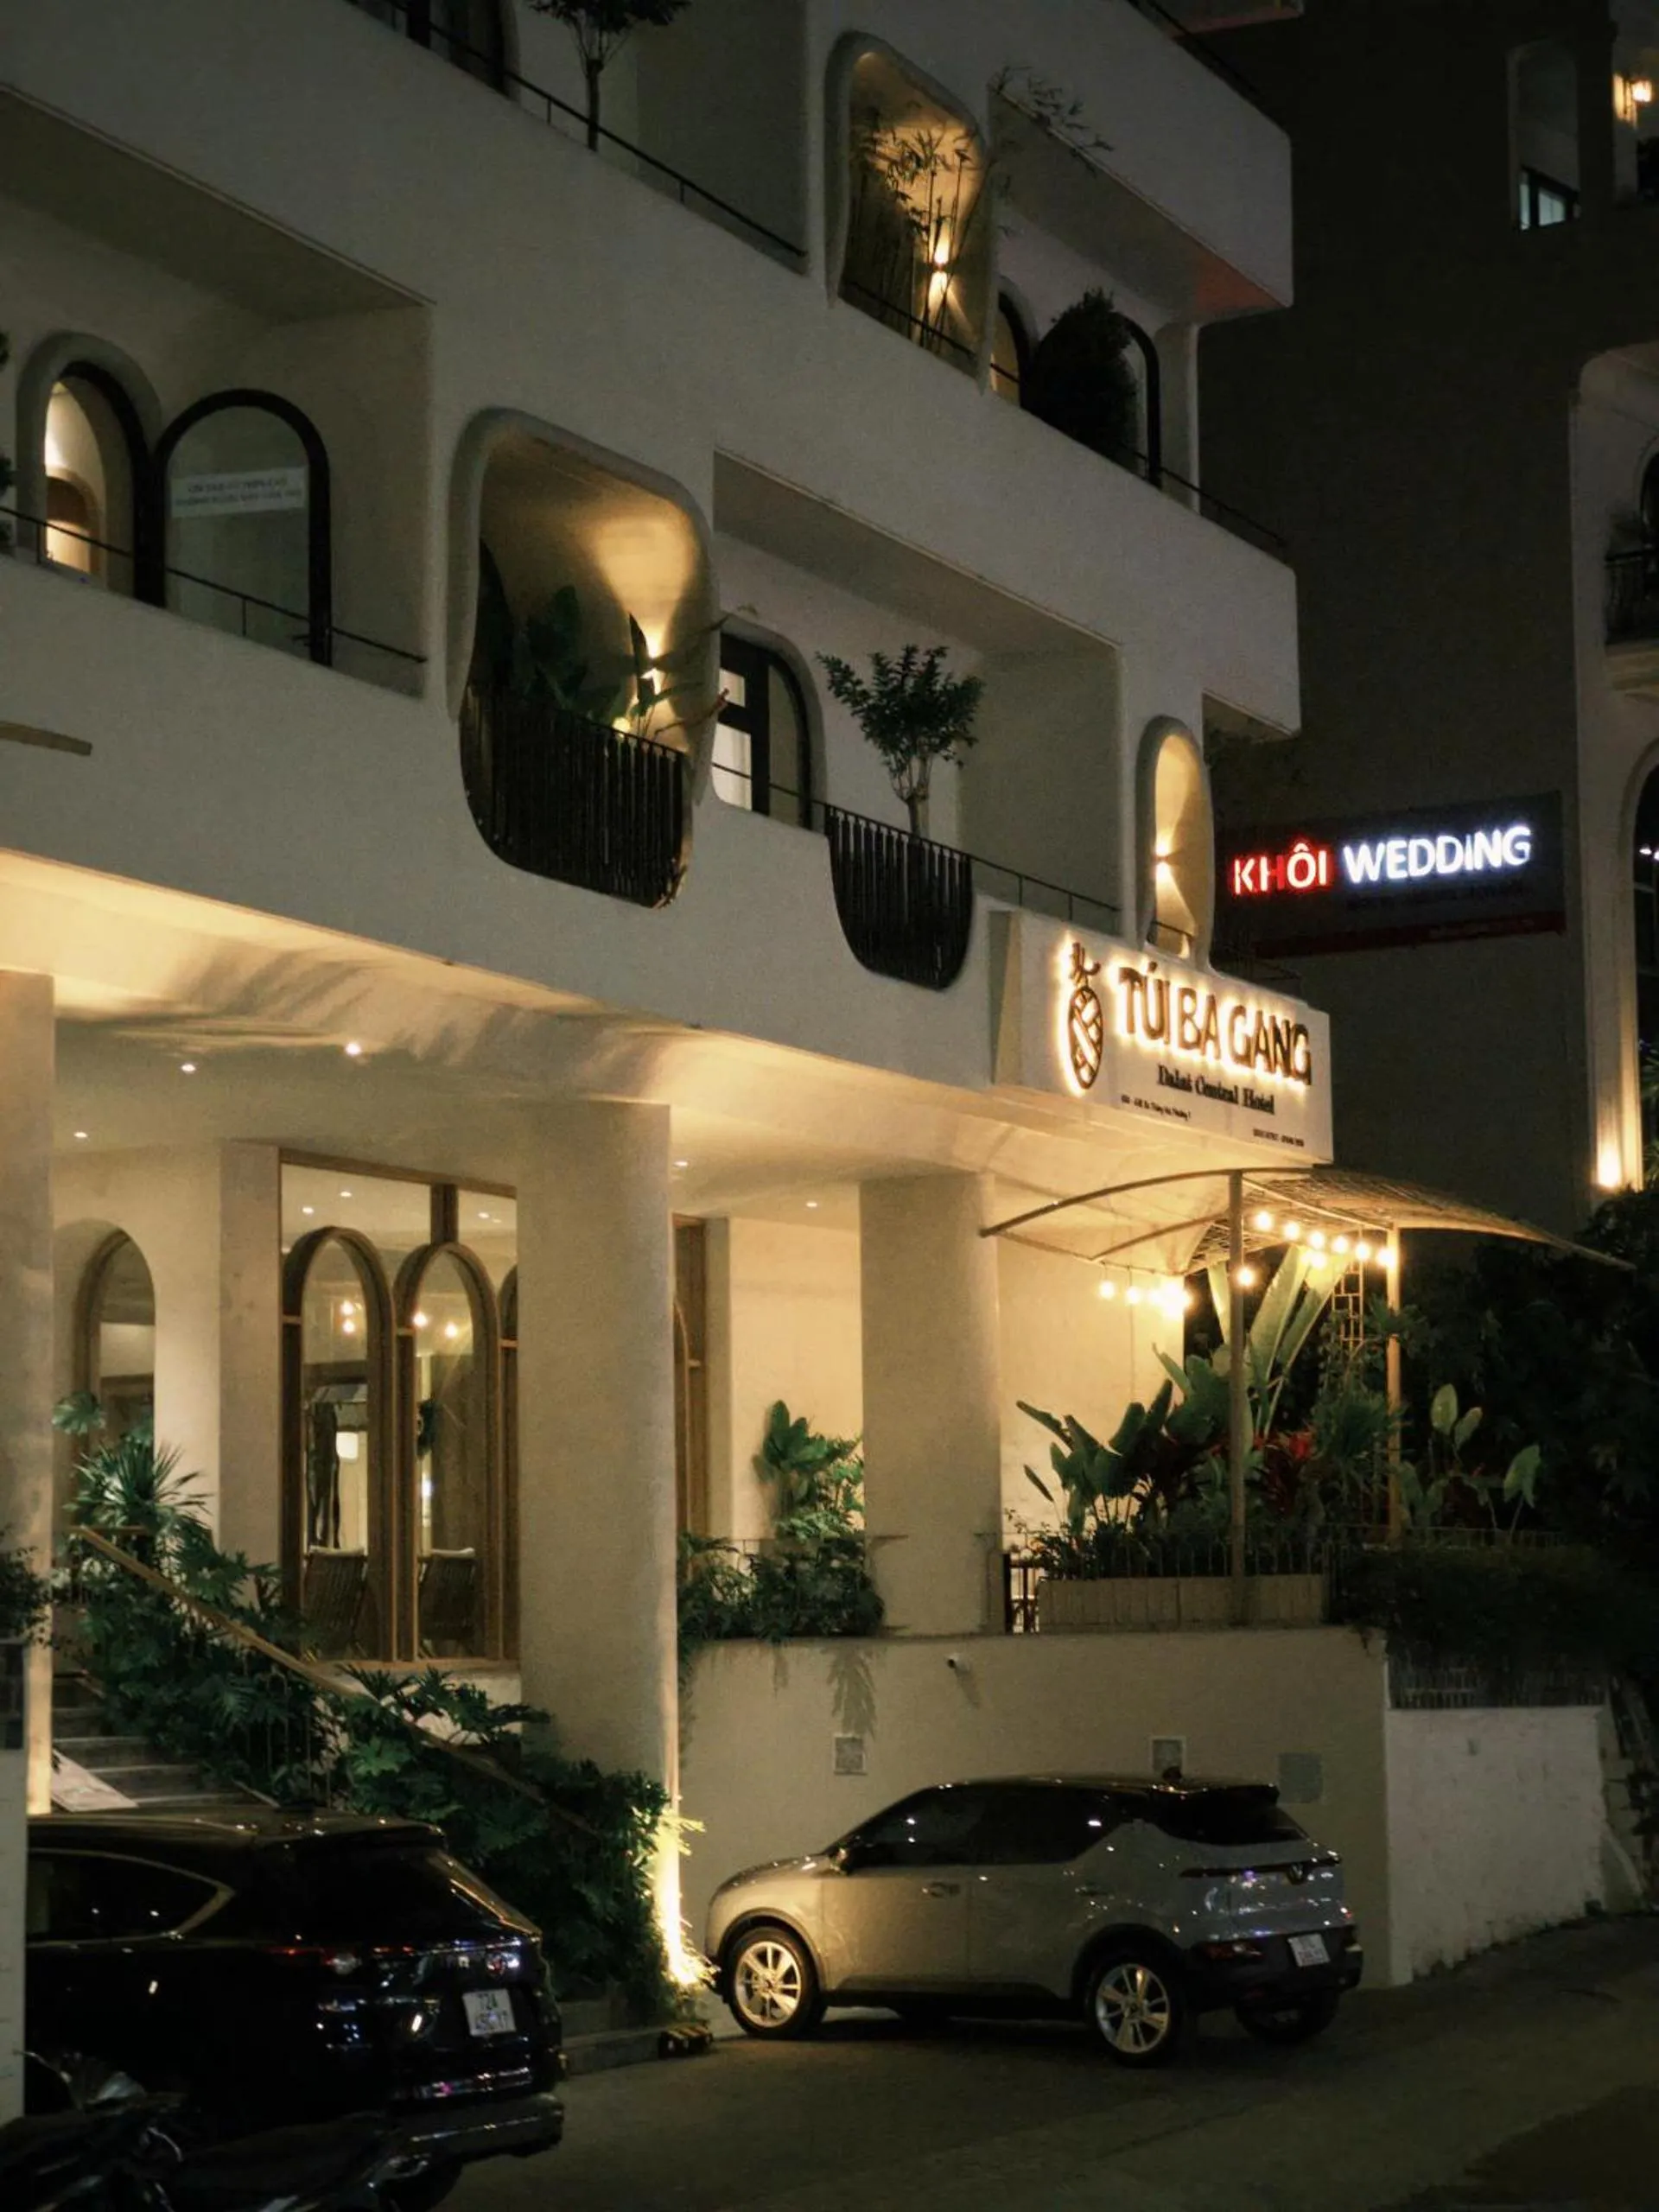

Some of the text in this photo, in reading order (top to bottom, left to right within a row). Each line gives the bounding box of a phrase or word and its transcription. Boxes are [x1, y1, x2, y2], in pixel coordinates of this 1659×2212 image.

[1232, 842, 1329, 895] KHÔI
[1342, 825, 1532, 885] WEDDING
[1117, 961, 1313, 1086] TÚI BA GANG
[1242, 1087, 1275, 1116] Hotel
